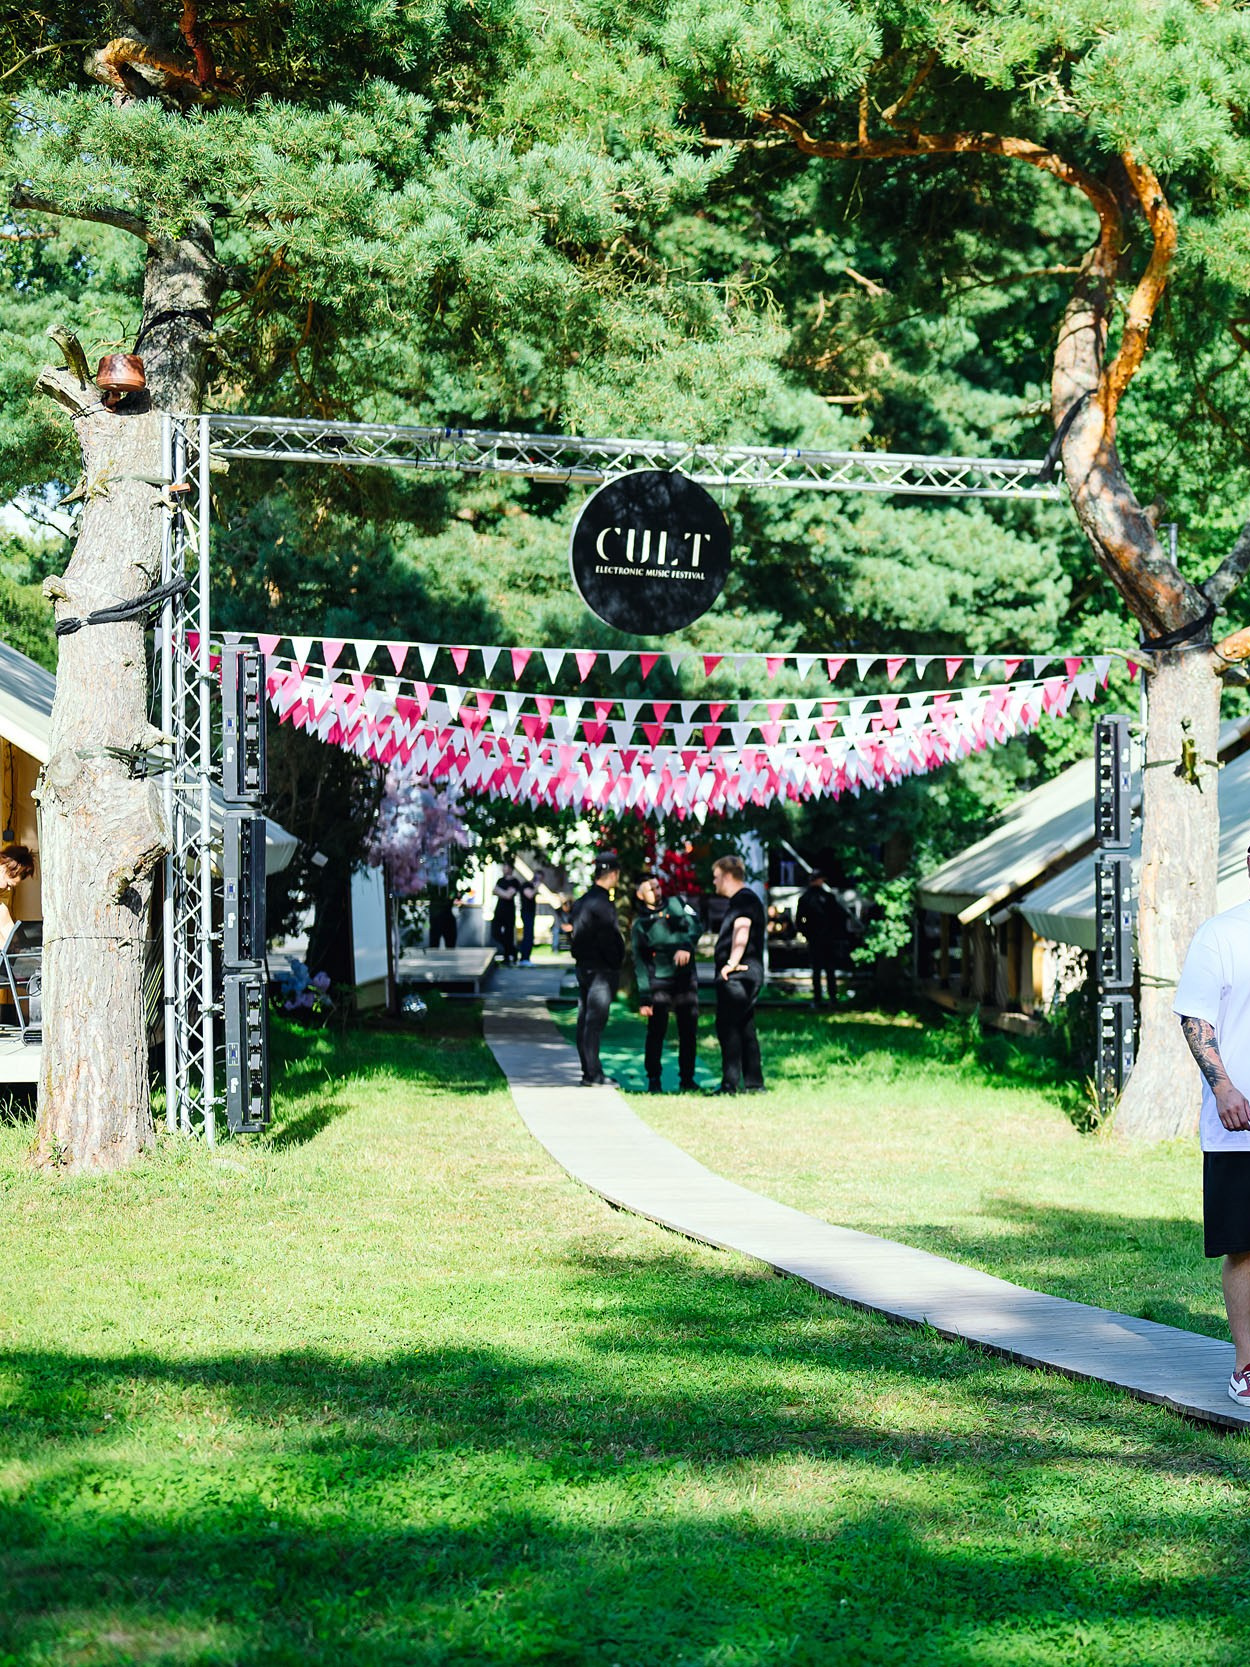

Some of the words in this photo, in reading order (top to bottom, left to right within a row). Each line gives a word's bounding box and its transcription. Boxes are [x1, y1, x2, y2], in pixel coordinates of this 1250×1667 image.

[596, 527, 711, 568] CULT
[595, 565, 644, 576] ELECTRONIC
[645, 569, 671, 578] MUSIC
[671, 570, 705, 580] FESTIVAL
